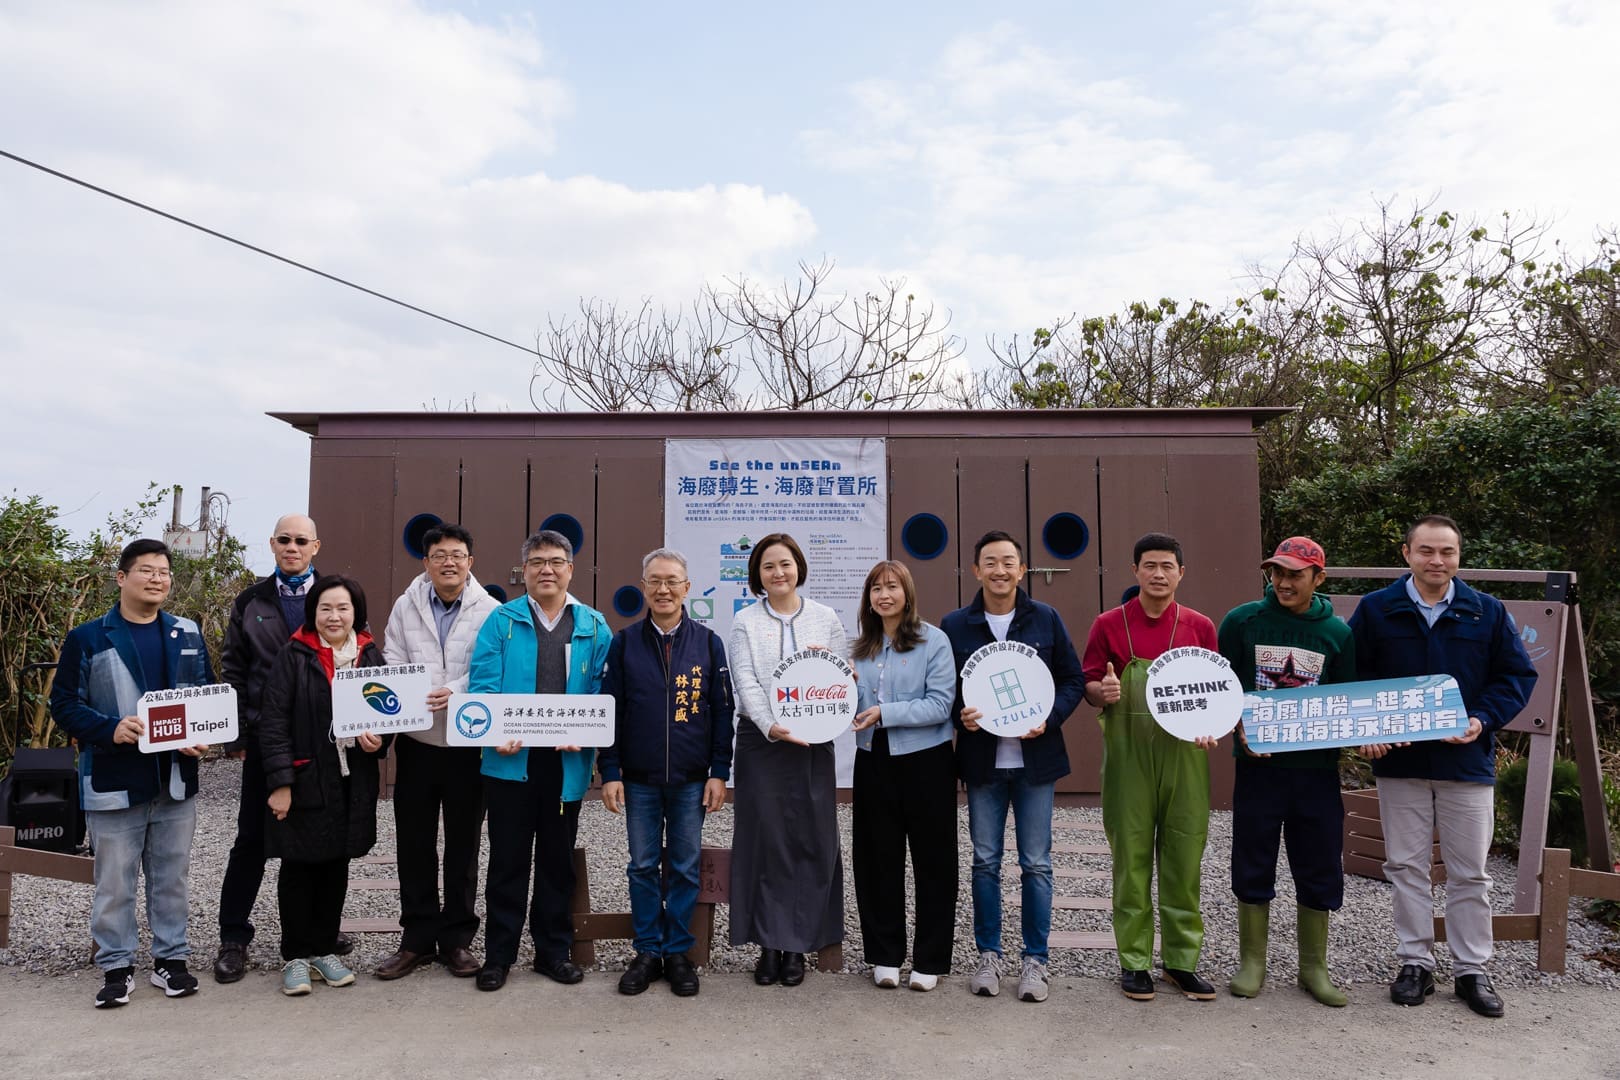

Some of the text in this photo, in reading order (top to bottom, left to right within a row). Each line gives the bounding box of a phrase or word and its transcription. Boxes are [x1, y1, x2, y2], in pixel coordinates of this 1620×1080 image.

[709, 460, 740, 471] See
[746, 460, 774, 471] the
[779, 702, 850, 718] 太古可口可樂
[1156, 698, 1208, 714] 重新思考
[153, 717, 182, 727] IMPACT
[190, 717, 229, 733] Taipei
[153, 724, 183, 738] HUB
[17, 825, 64, 841] MIPRO
